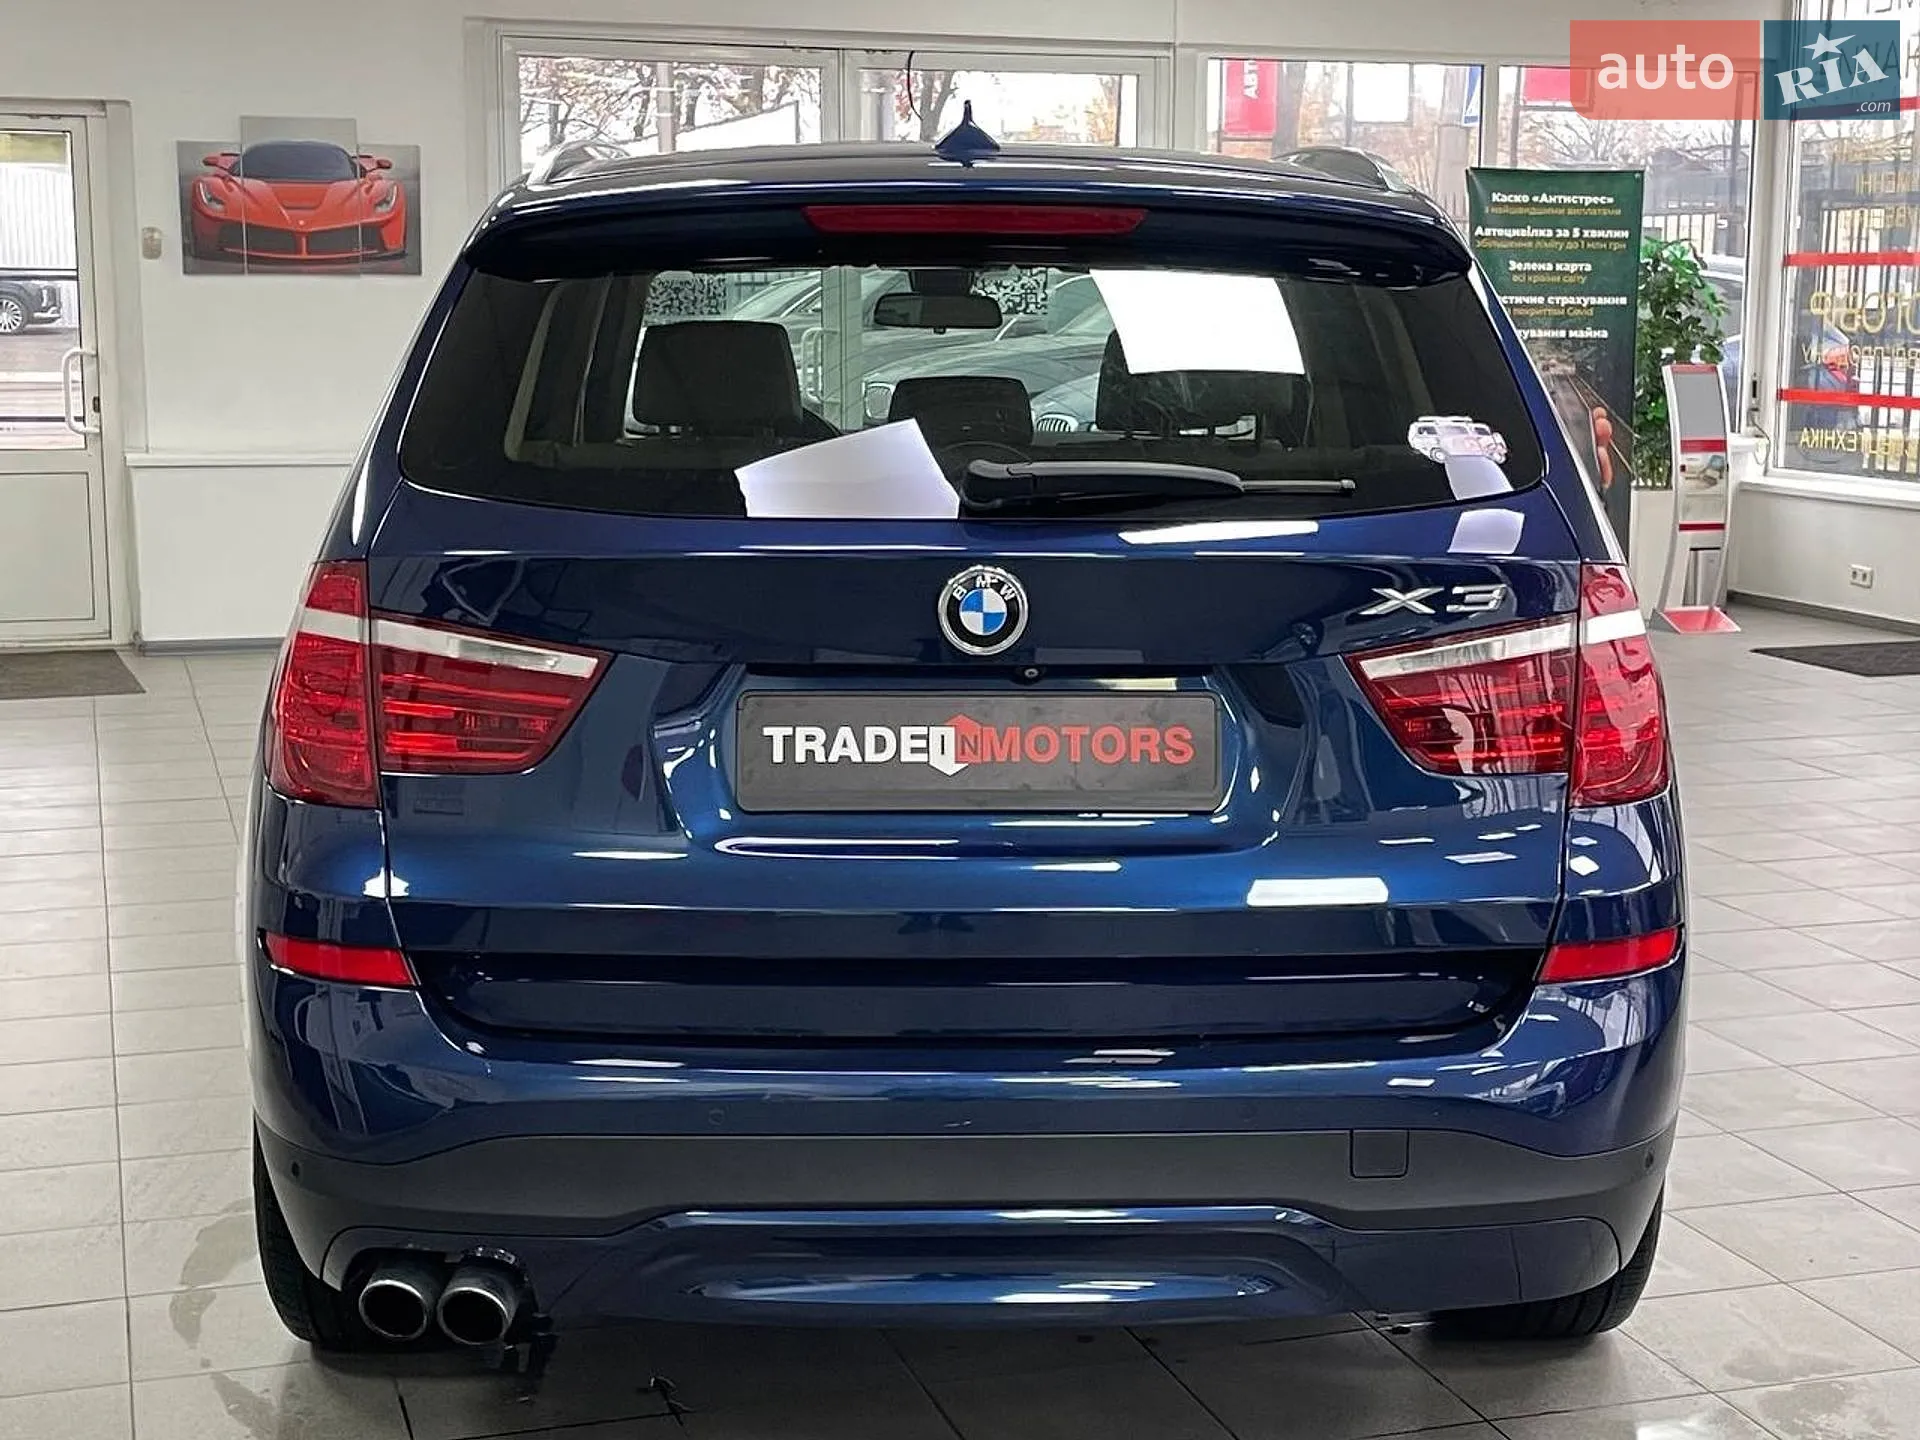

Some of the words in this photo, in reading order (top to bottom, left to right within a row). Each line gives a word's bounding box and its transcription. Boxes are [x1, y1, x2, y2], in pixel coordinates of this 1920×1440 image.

[1492, 192, 1529, 204] Каско
[1532, 193, 1615, 206] «Антистрес»
[1475, 226, 1553, 239] Автоцивілка
[1555, 229, 1570, 238] за
[1573, 228, 1581, 238] 5
[1582, 229, 1629, 239] хвилин
[1566, 241, 1580, 250] до
[1508, 260, 1552, 271] Зелена
[1555, 262, 1592, 273] карта
[1547, 296, 1628, 307] страхування
[1566, 308, 1593, 316] Covid
[1569, 327, 1609, 339] майна
[952, 575, 1017, 601] BMW
[1358, 583, 1507, 616] X3
